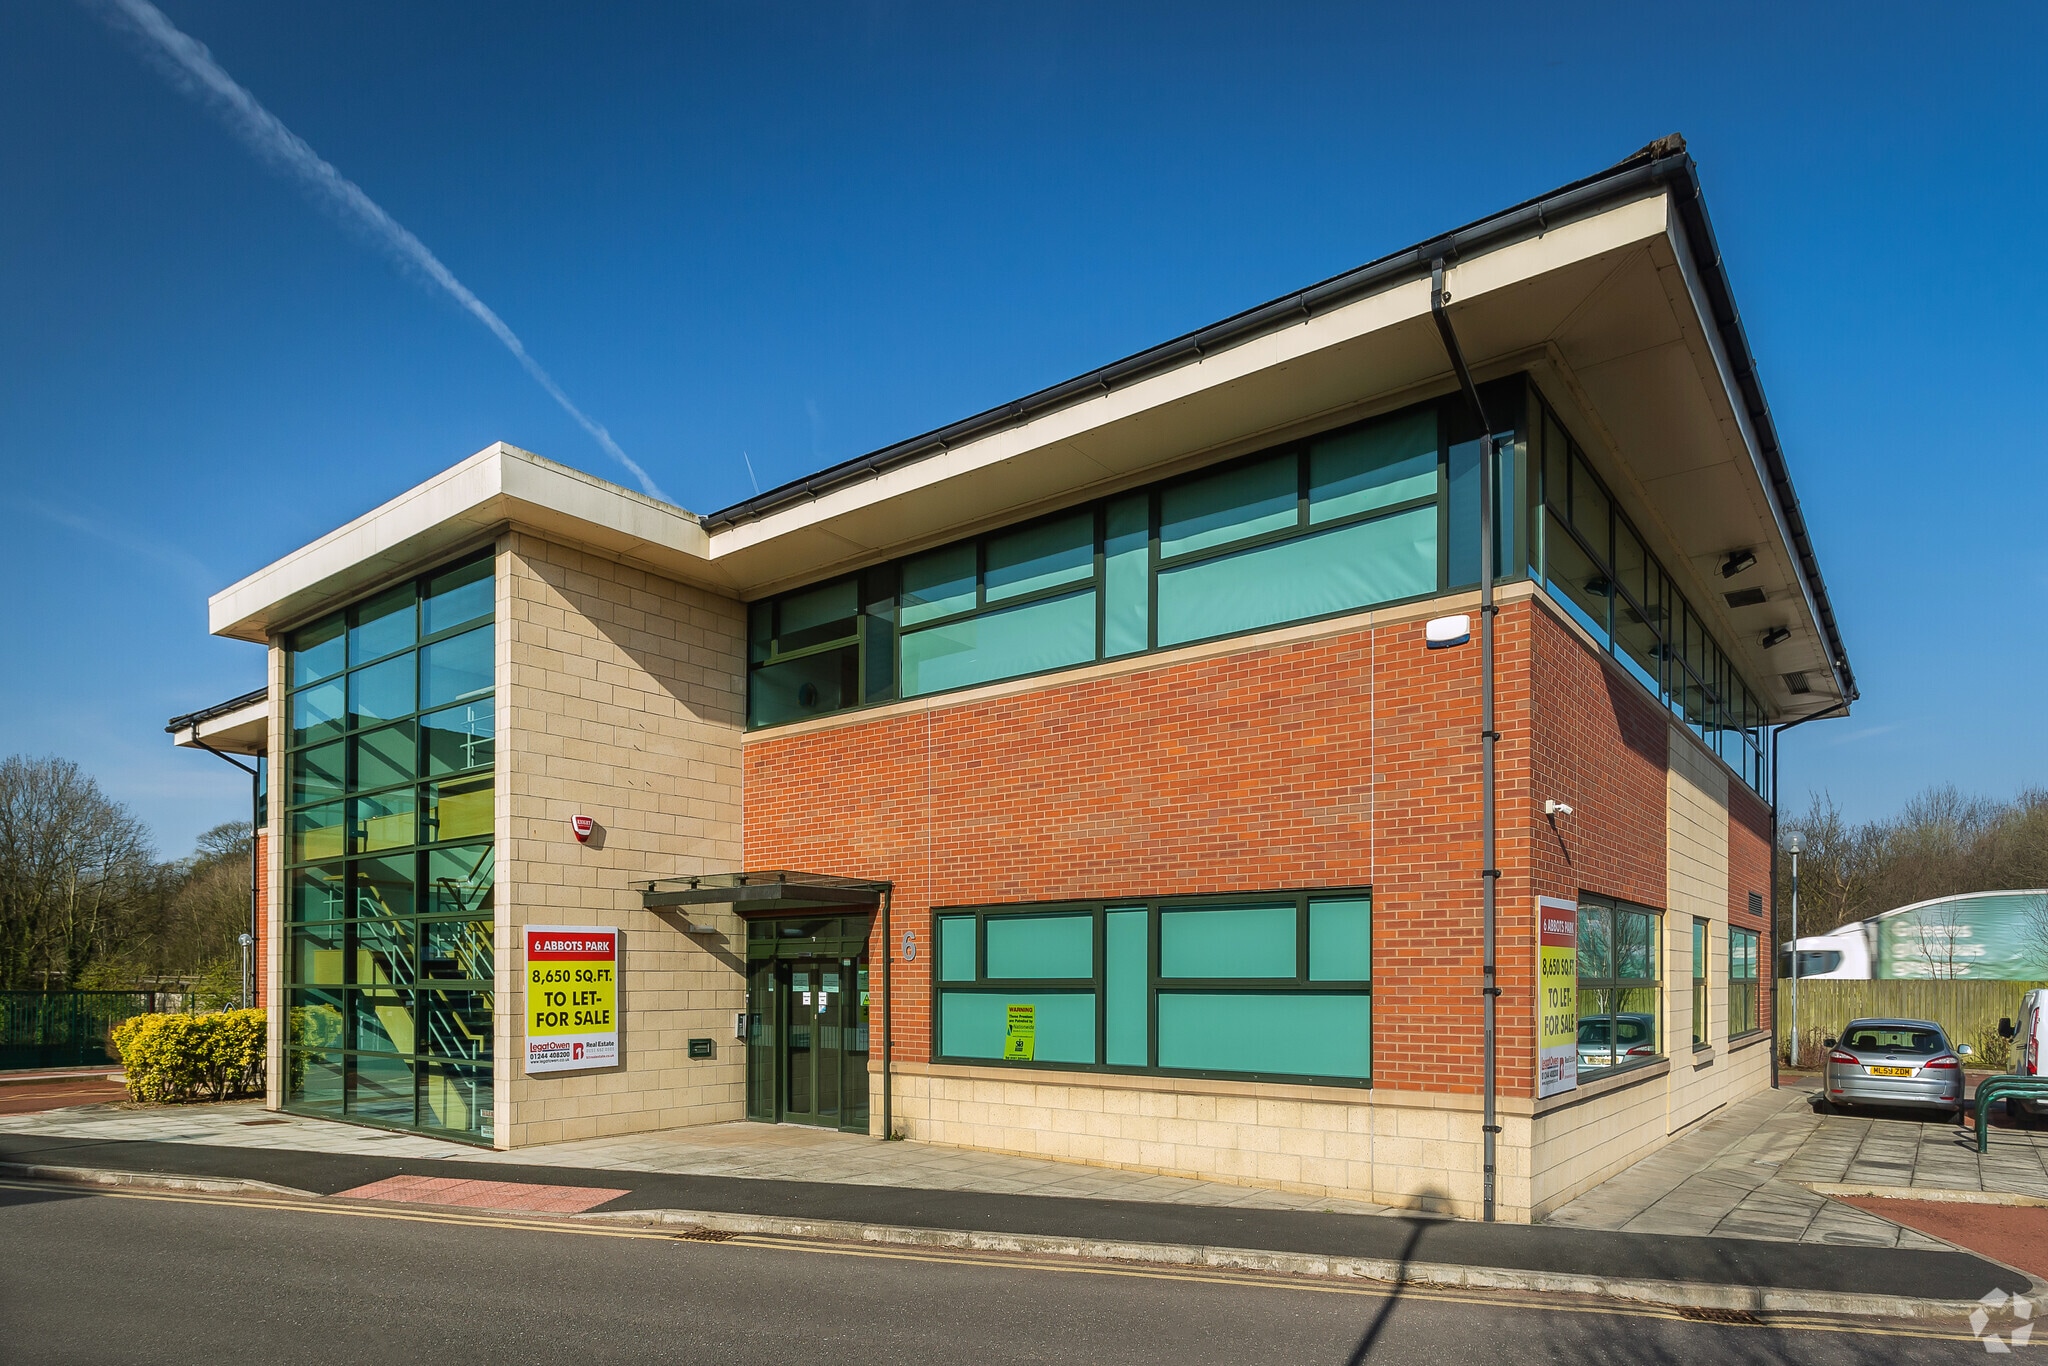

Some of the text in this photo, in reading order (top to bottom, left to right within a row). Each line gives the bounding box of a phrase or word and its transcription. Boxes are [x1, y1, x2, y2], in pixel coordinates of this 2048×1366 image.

[1548, 919, 1564, 933] ABBOTS
[1565, 921, 1575, 934] PARK
[534, 941, 610, 951] 6 ABBOTS PARK
[902, 931, 916, 961] 6
[1542, 957, 1560, 978] 8,650
[532, 969, 612, 985] 8,650 SQ.FT.
[544, 991, 602, 1007] TO LET-
[1548, 987, 1572, 1008] TO LET-
[536, 1010, 610, 1027] FOR SALE
[1544, 1013, 1574, 1036] FOR SALE
